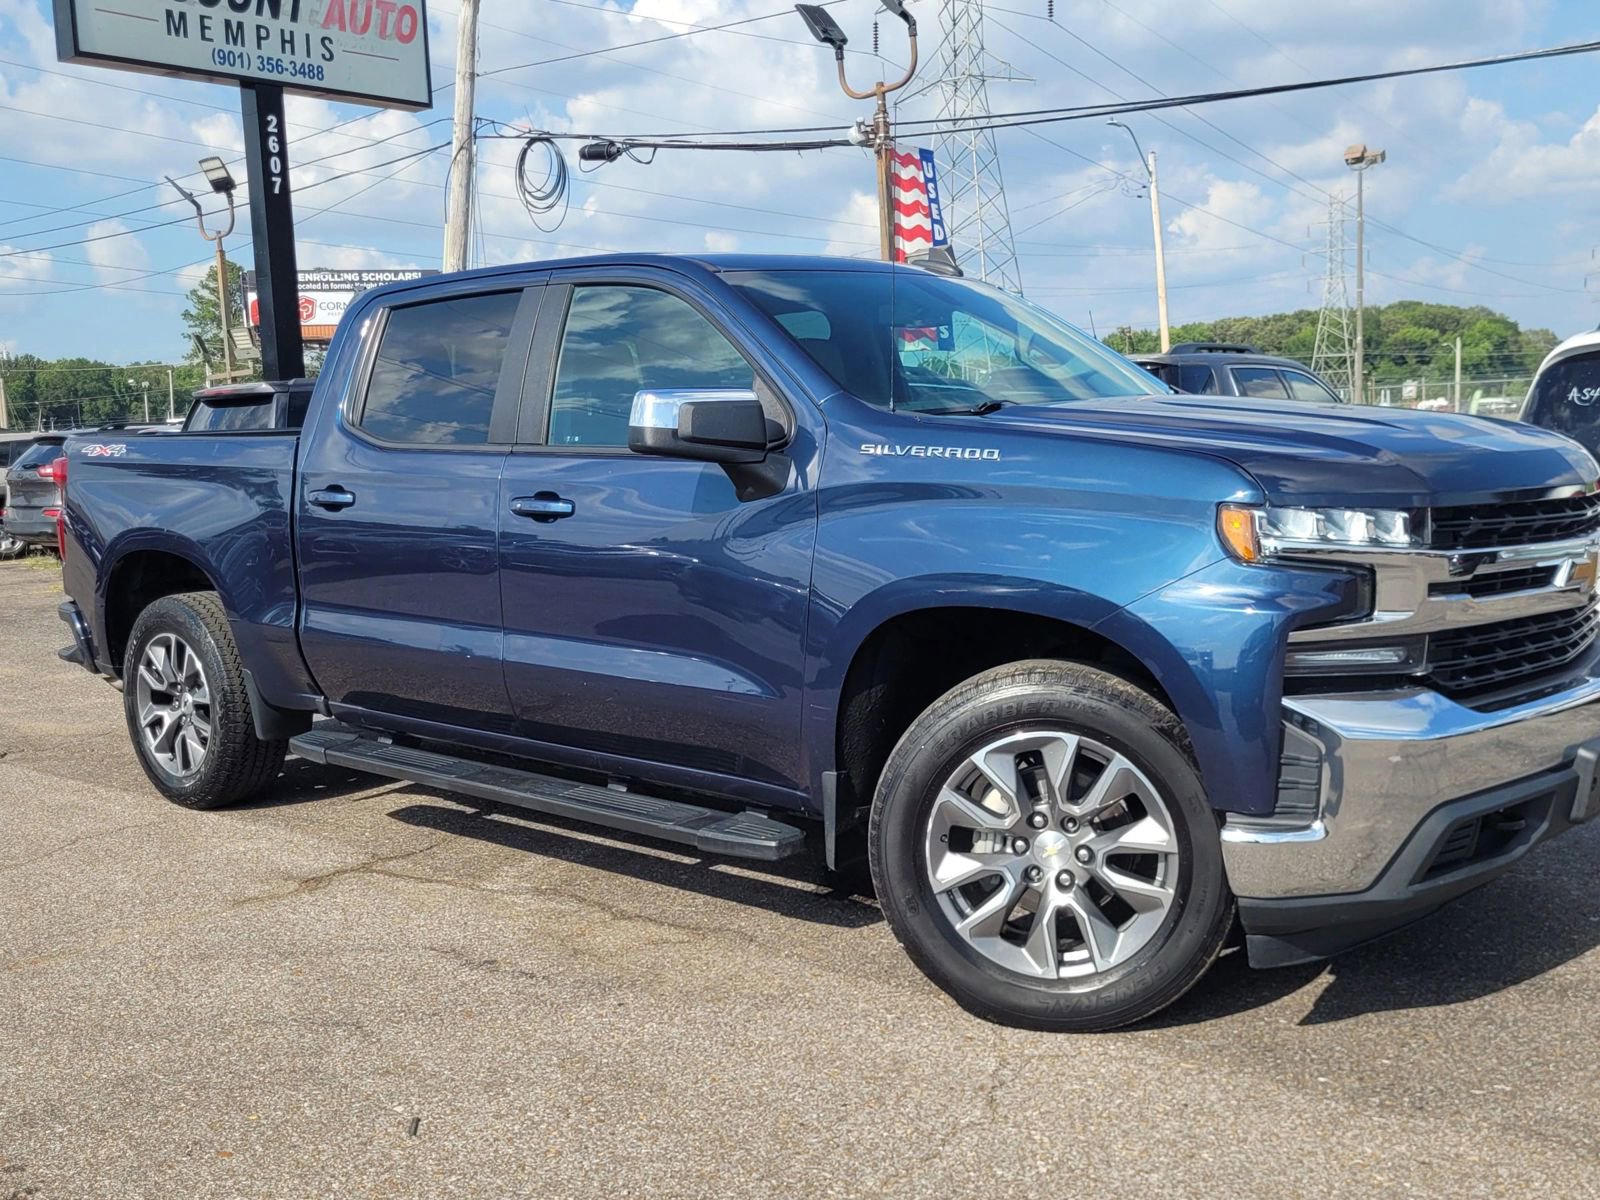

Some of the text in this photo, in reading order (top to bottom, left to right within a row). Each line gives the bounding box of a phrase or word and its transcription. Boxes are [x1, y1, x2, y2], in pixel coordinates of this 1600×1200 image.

[165, 9, 335, 62] MEMPHIS
[320, 0, 418, 44] AUTO
[212, 48, 325, 81] (901) 356-3488
[266, 115, 282, 194] 2607
[922, 160, 945, 241] USED
[298, 272, 360, 282] ENROLLING
[860, 444, 1001, 461] SILVERADO
